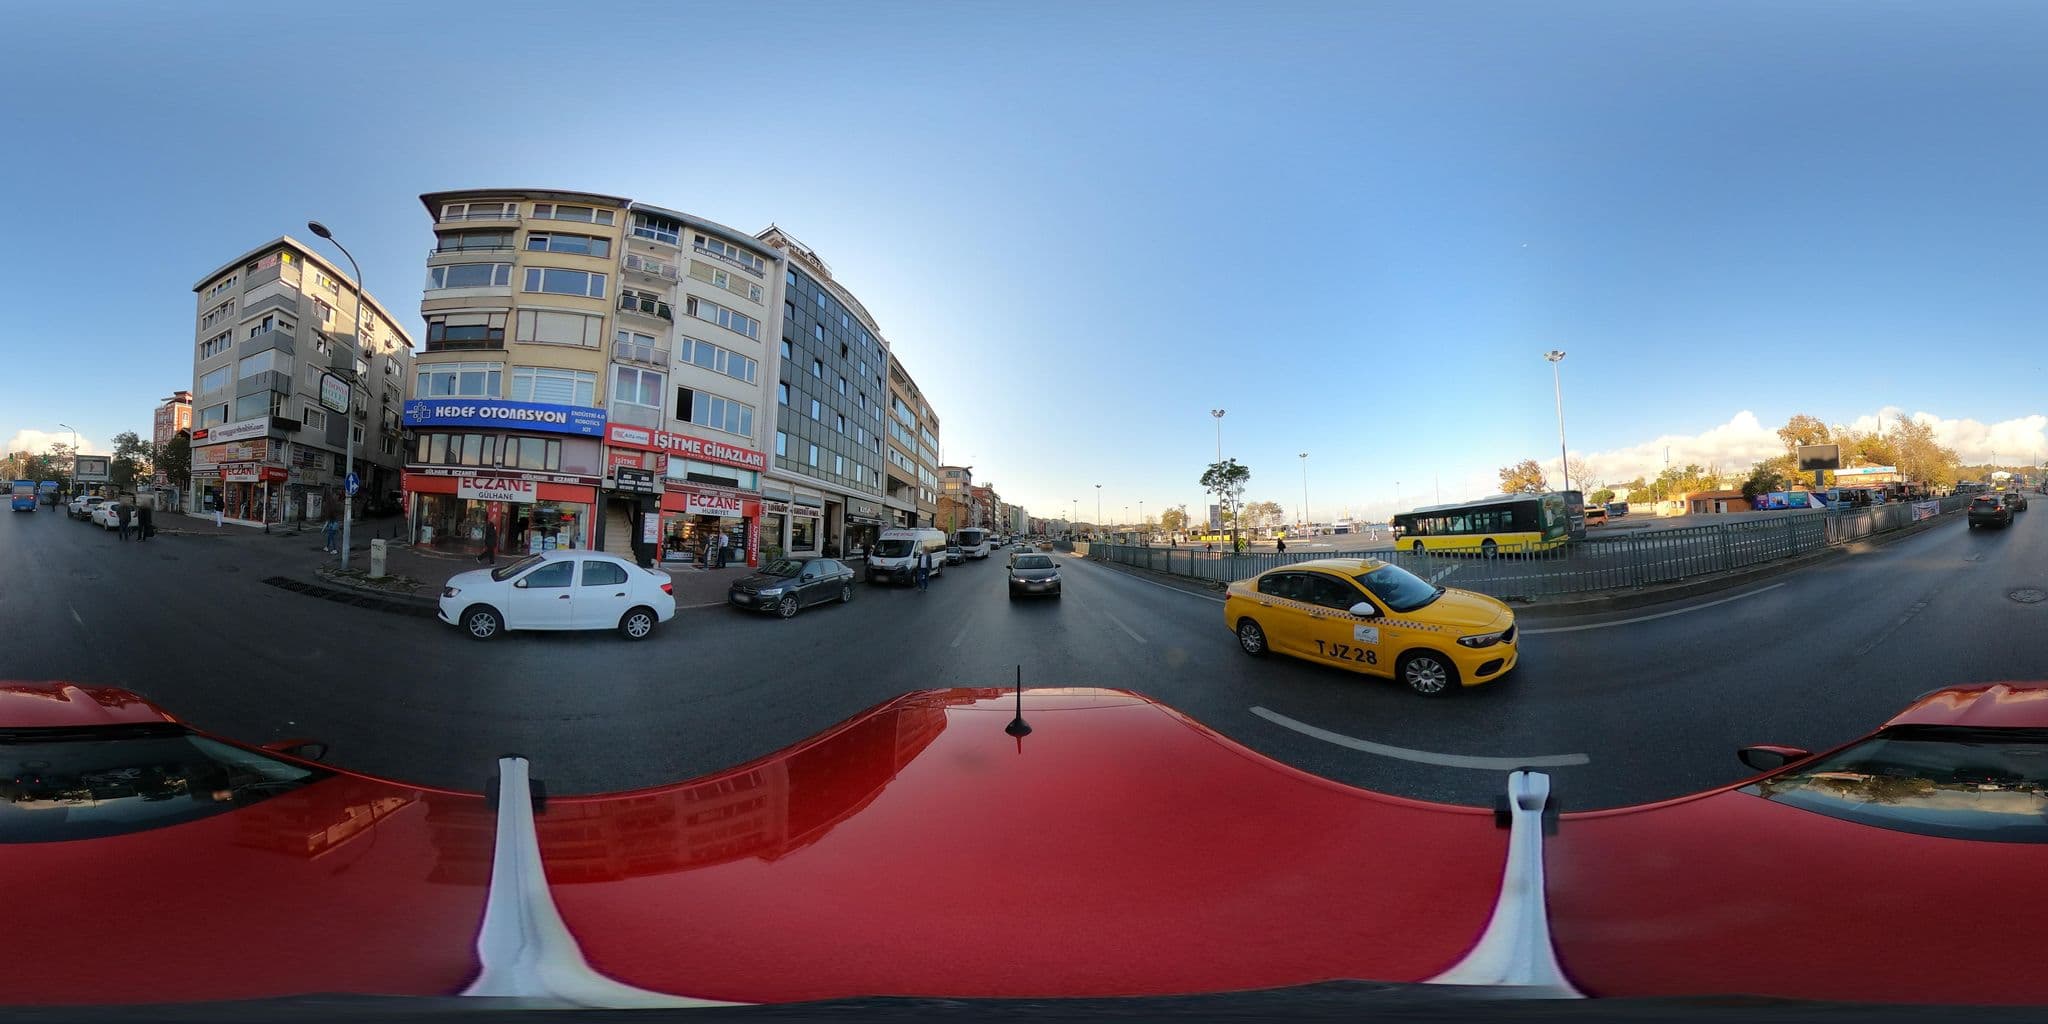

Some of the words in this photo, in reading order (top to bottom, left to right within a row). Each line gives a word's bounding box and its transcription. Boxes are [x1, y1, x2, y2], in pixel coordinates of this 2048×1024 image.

[435, 406, 476, 417] HEDEF
[479, 406, 566, 424] OTOMASYON
[653, 430, 701, 453] İŞİTME
[703, 442, 763, 467] CİHAZLARI
[462, 477, 532, 492] ECZANE
[478, 490, 514, 500] GÜLHANE
[690, 494, 740, 510] ECZANE
[751, 525, 759, 561] PHARMACY
[1354, 648, 1377, 664] 28
